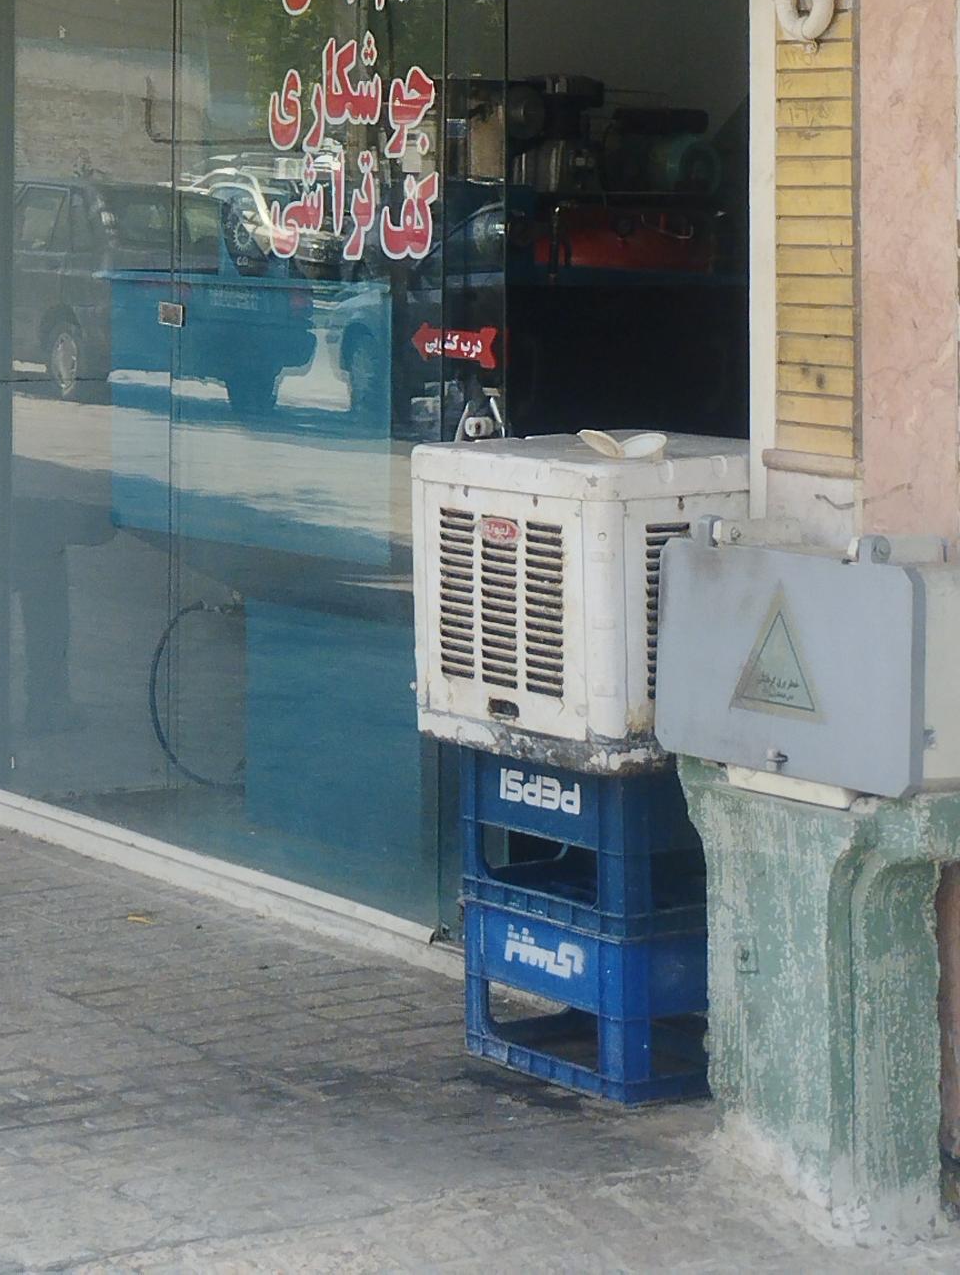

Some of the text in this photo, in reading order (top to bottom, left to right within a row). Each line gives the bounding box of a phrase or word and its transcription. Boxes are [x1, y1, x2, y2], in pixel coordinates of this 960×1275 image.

[270, 151, 439, 261] کف تراشی
[499, 767, 582, 816] PEPSI
